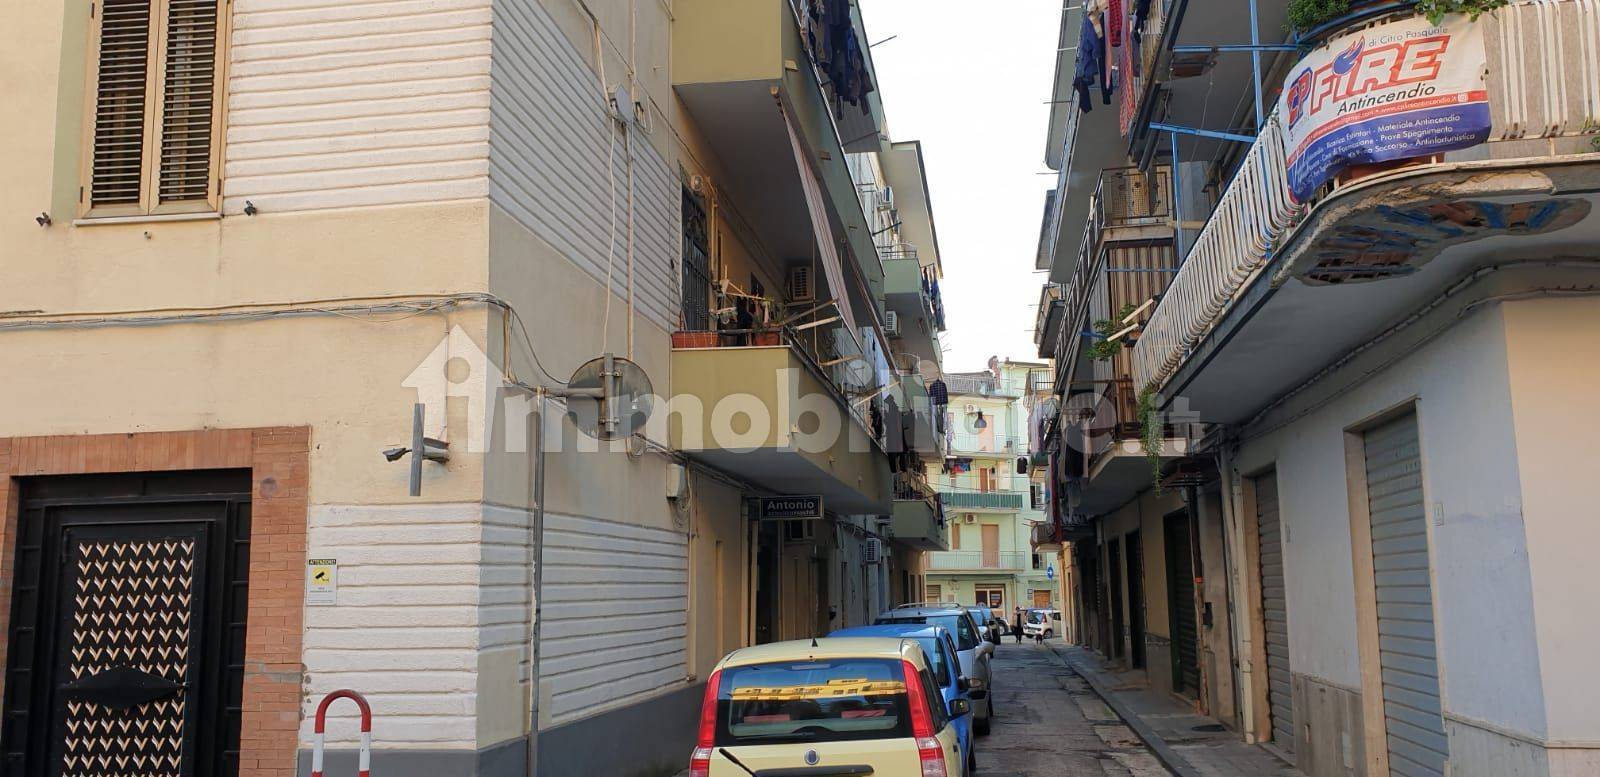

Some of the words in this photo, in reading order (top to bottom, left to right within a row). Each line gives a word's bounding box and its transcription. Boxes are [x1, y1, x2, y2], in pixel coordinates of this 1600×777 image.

[1368, 38, 1377, 48] di
[1406, 26, 1449, 39] Pasquale
[1337, 83, 1437, 116] Antincendio
[1378, 120, 1413, 133] Materiale
[1414, 114, 1461, 127] Antincendio
[1380, 132, 1402, 142] Prove
[1402, 126, 1454, 140] Spegnimento
[1375, 141, 1408, 153] Soccorso
[767, 500, 815, 511] Antonio
